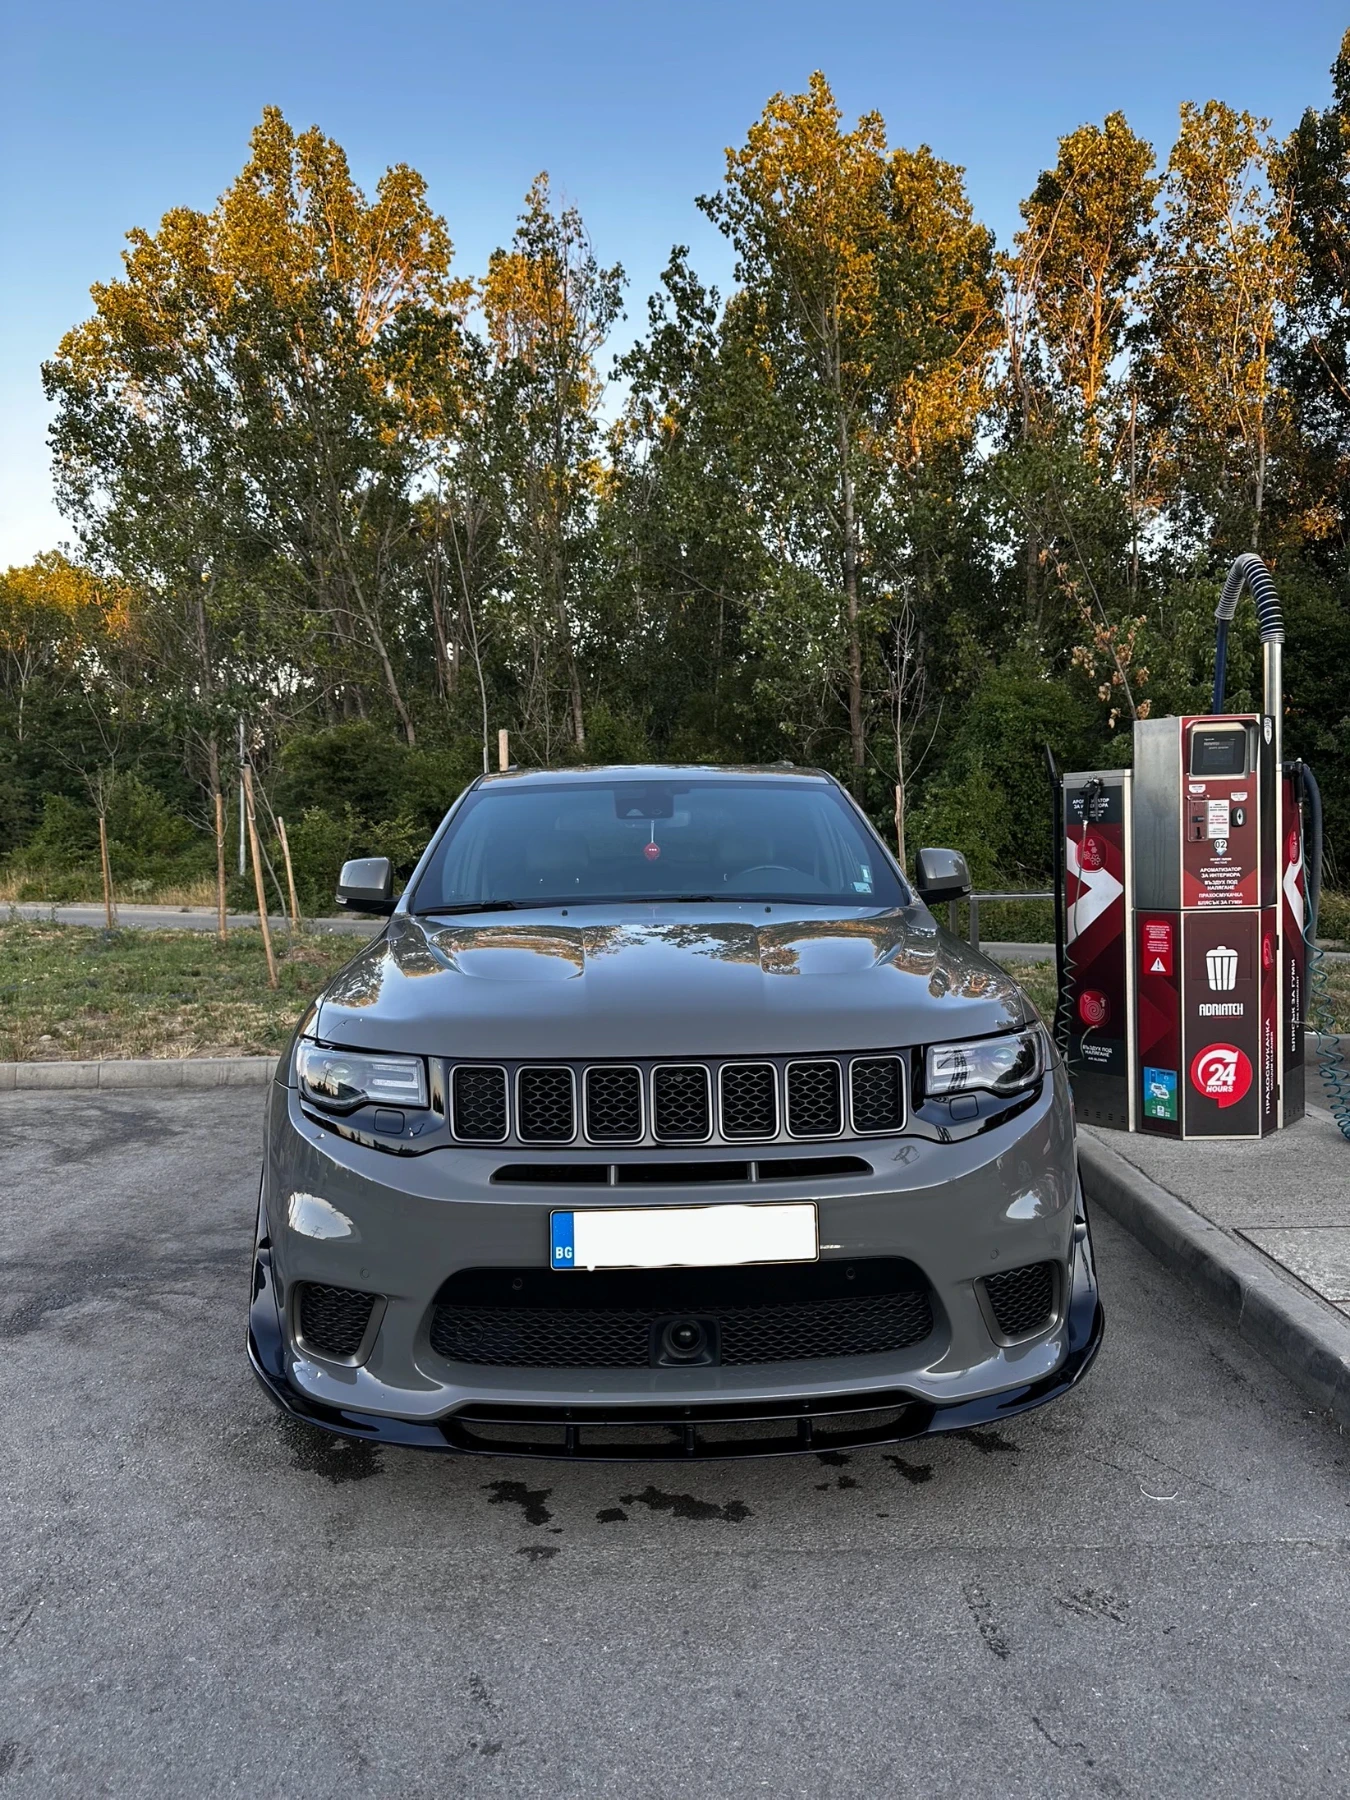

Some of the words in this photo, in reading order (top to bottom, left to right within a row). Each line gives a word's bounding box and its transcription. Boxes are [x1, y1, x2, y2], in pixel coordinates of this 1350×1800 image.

[1215, 840, 1226, 848] 02
[1291, 990, 1296, 1005] ЗА
[1206, 1062, 1237, 1086] 24
[1205, 1085, 1234, 1093] HOURS
[555, 1246, 573, 1259] BG
